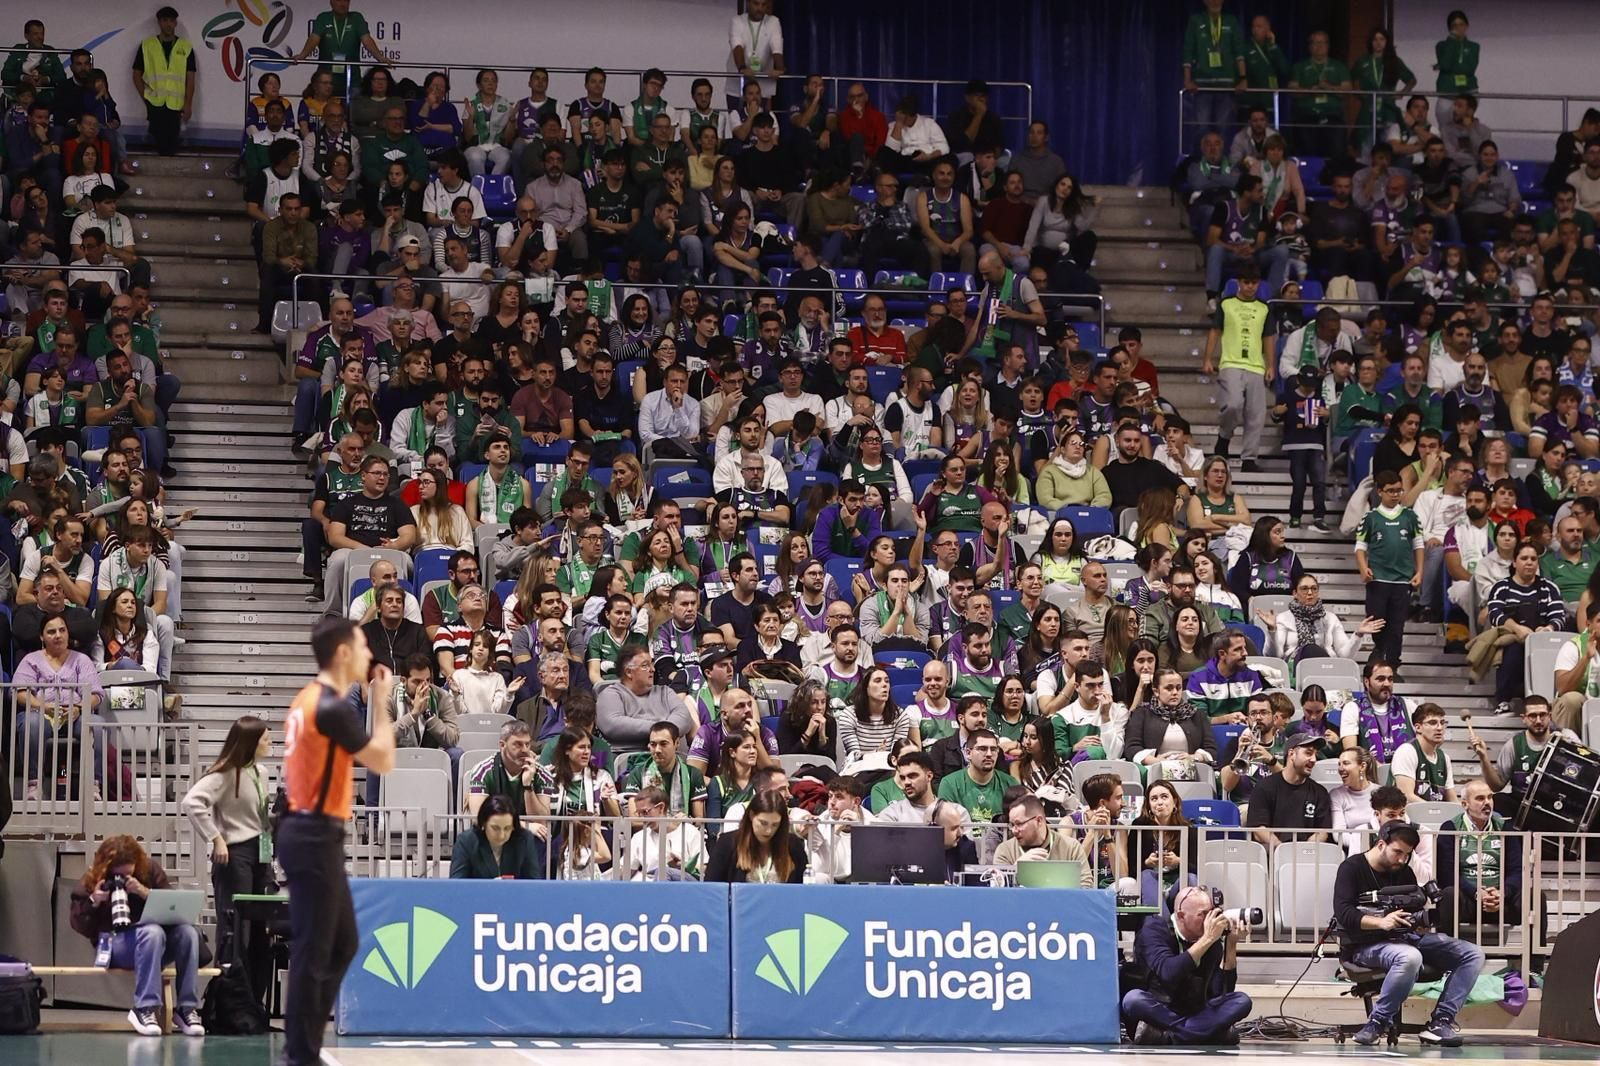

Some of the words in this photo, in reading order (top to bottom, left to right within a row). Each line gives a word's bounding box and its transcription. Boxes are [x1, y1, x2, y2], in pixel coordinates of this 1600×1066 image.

[1263, 581, 1290, 590] Unicaja
[474, 912, 708, 953] Fundación
[864, 920, 1096, 961] Fundación
[474, 953, 642, 1005] Unicaja
[865, 960, 1031, 1012] Unicaja
